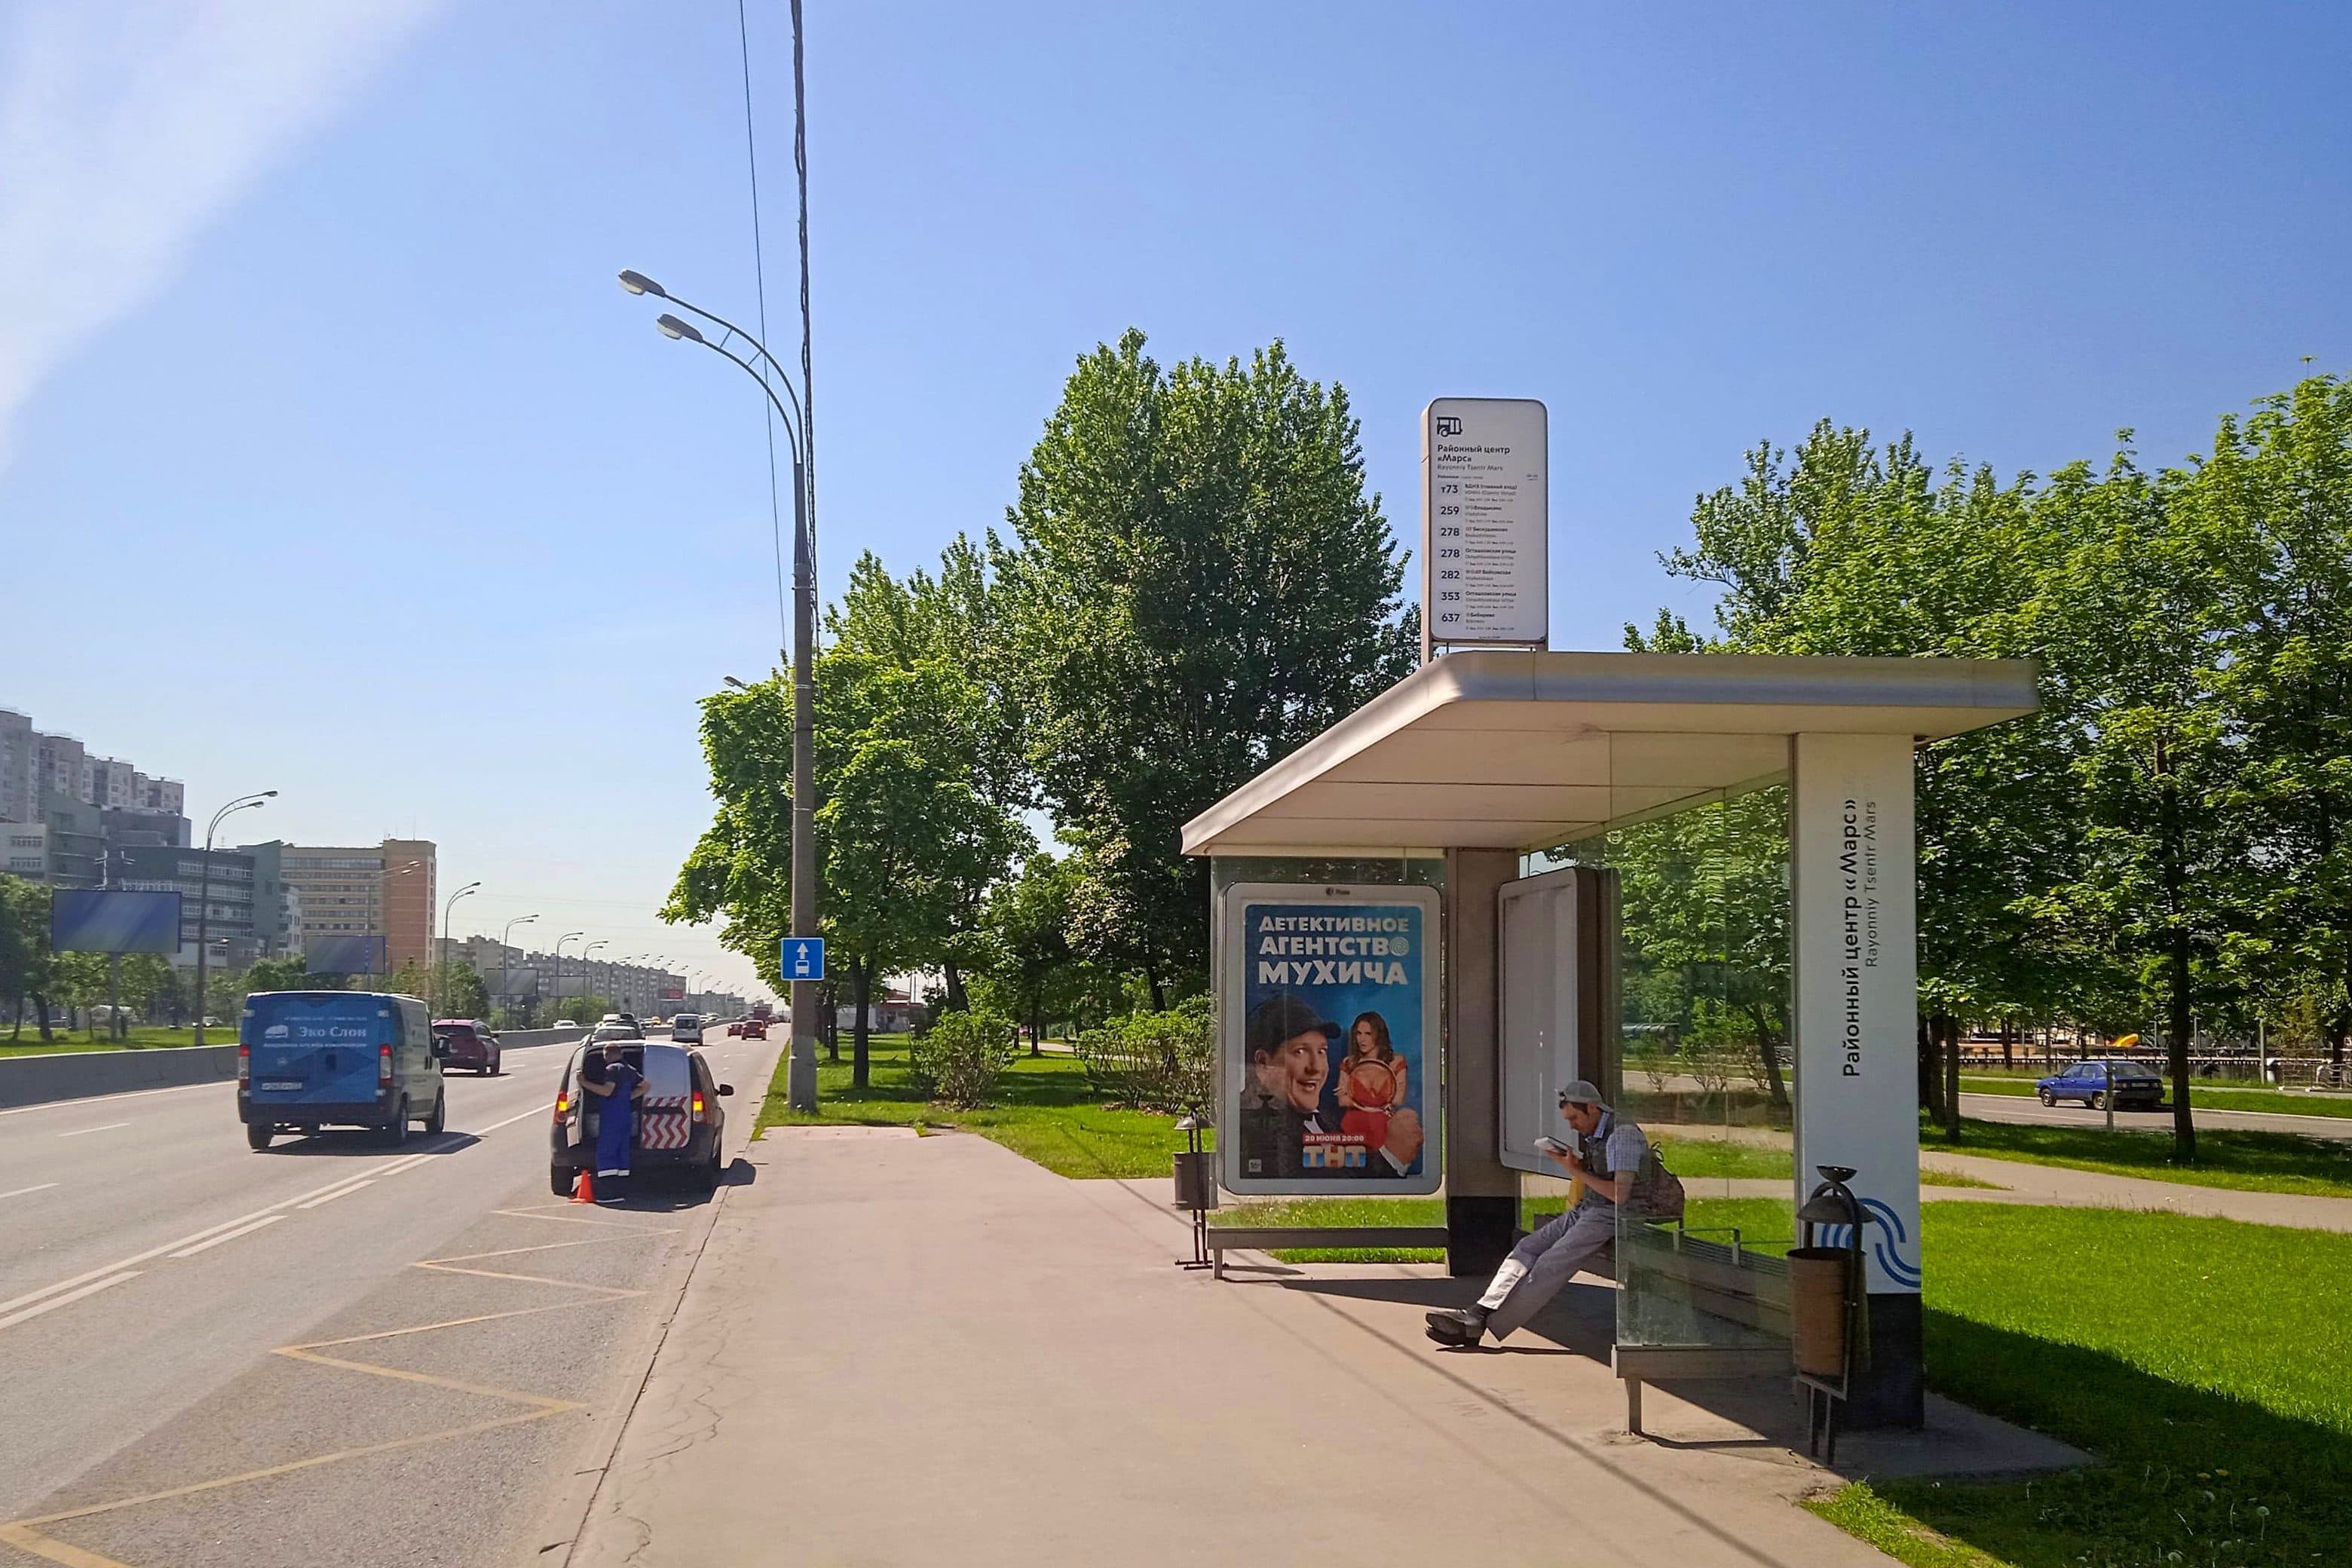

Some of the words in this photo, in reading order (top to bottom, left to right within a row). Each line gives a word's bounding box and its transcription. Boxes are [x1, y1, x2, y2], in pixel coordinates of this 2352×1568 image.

[1438, 454, 1472, 463] «Марс»
[1484, 446, 1511, 455] центр
[1441, 506, 1459, 515] 259
[1441, 528, 1460, 536] 278
[1441, 549, 1460, 558] 278
[1441, 570, 1460, 580] 282
[1441, 592, 1460, 601] 353
[1441, 613, 1460, 623] 637
[1864, 801, 1877, 842] Mars
[1839, 798, 1861, 891] «Марс»
[1864, 843, 1876, 893] Tsentr
[1259, 915, 1410, 933] ДЕТЕКТИВНОЕ
[1845, 896, 1862, 960] центр
[1865, 899, 1881, 967] Rayonniy
[1259, 936, 1410, 957] АГЕНТСТВО
[1258, 959, 1409, 986] МУХИЧА
[1840, 966, 1860, 1076] Районный
[299, 1026, 326, 1037] Эко
[330, 1026, 367, 1037] Слон
[1303, 1145, 1367, 1168] ТНТ
